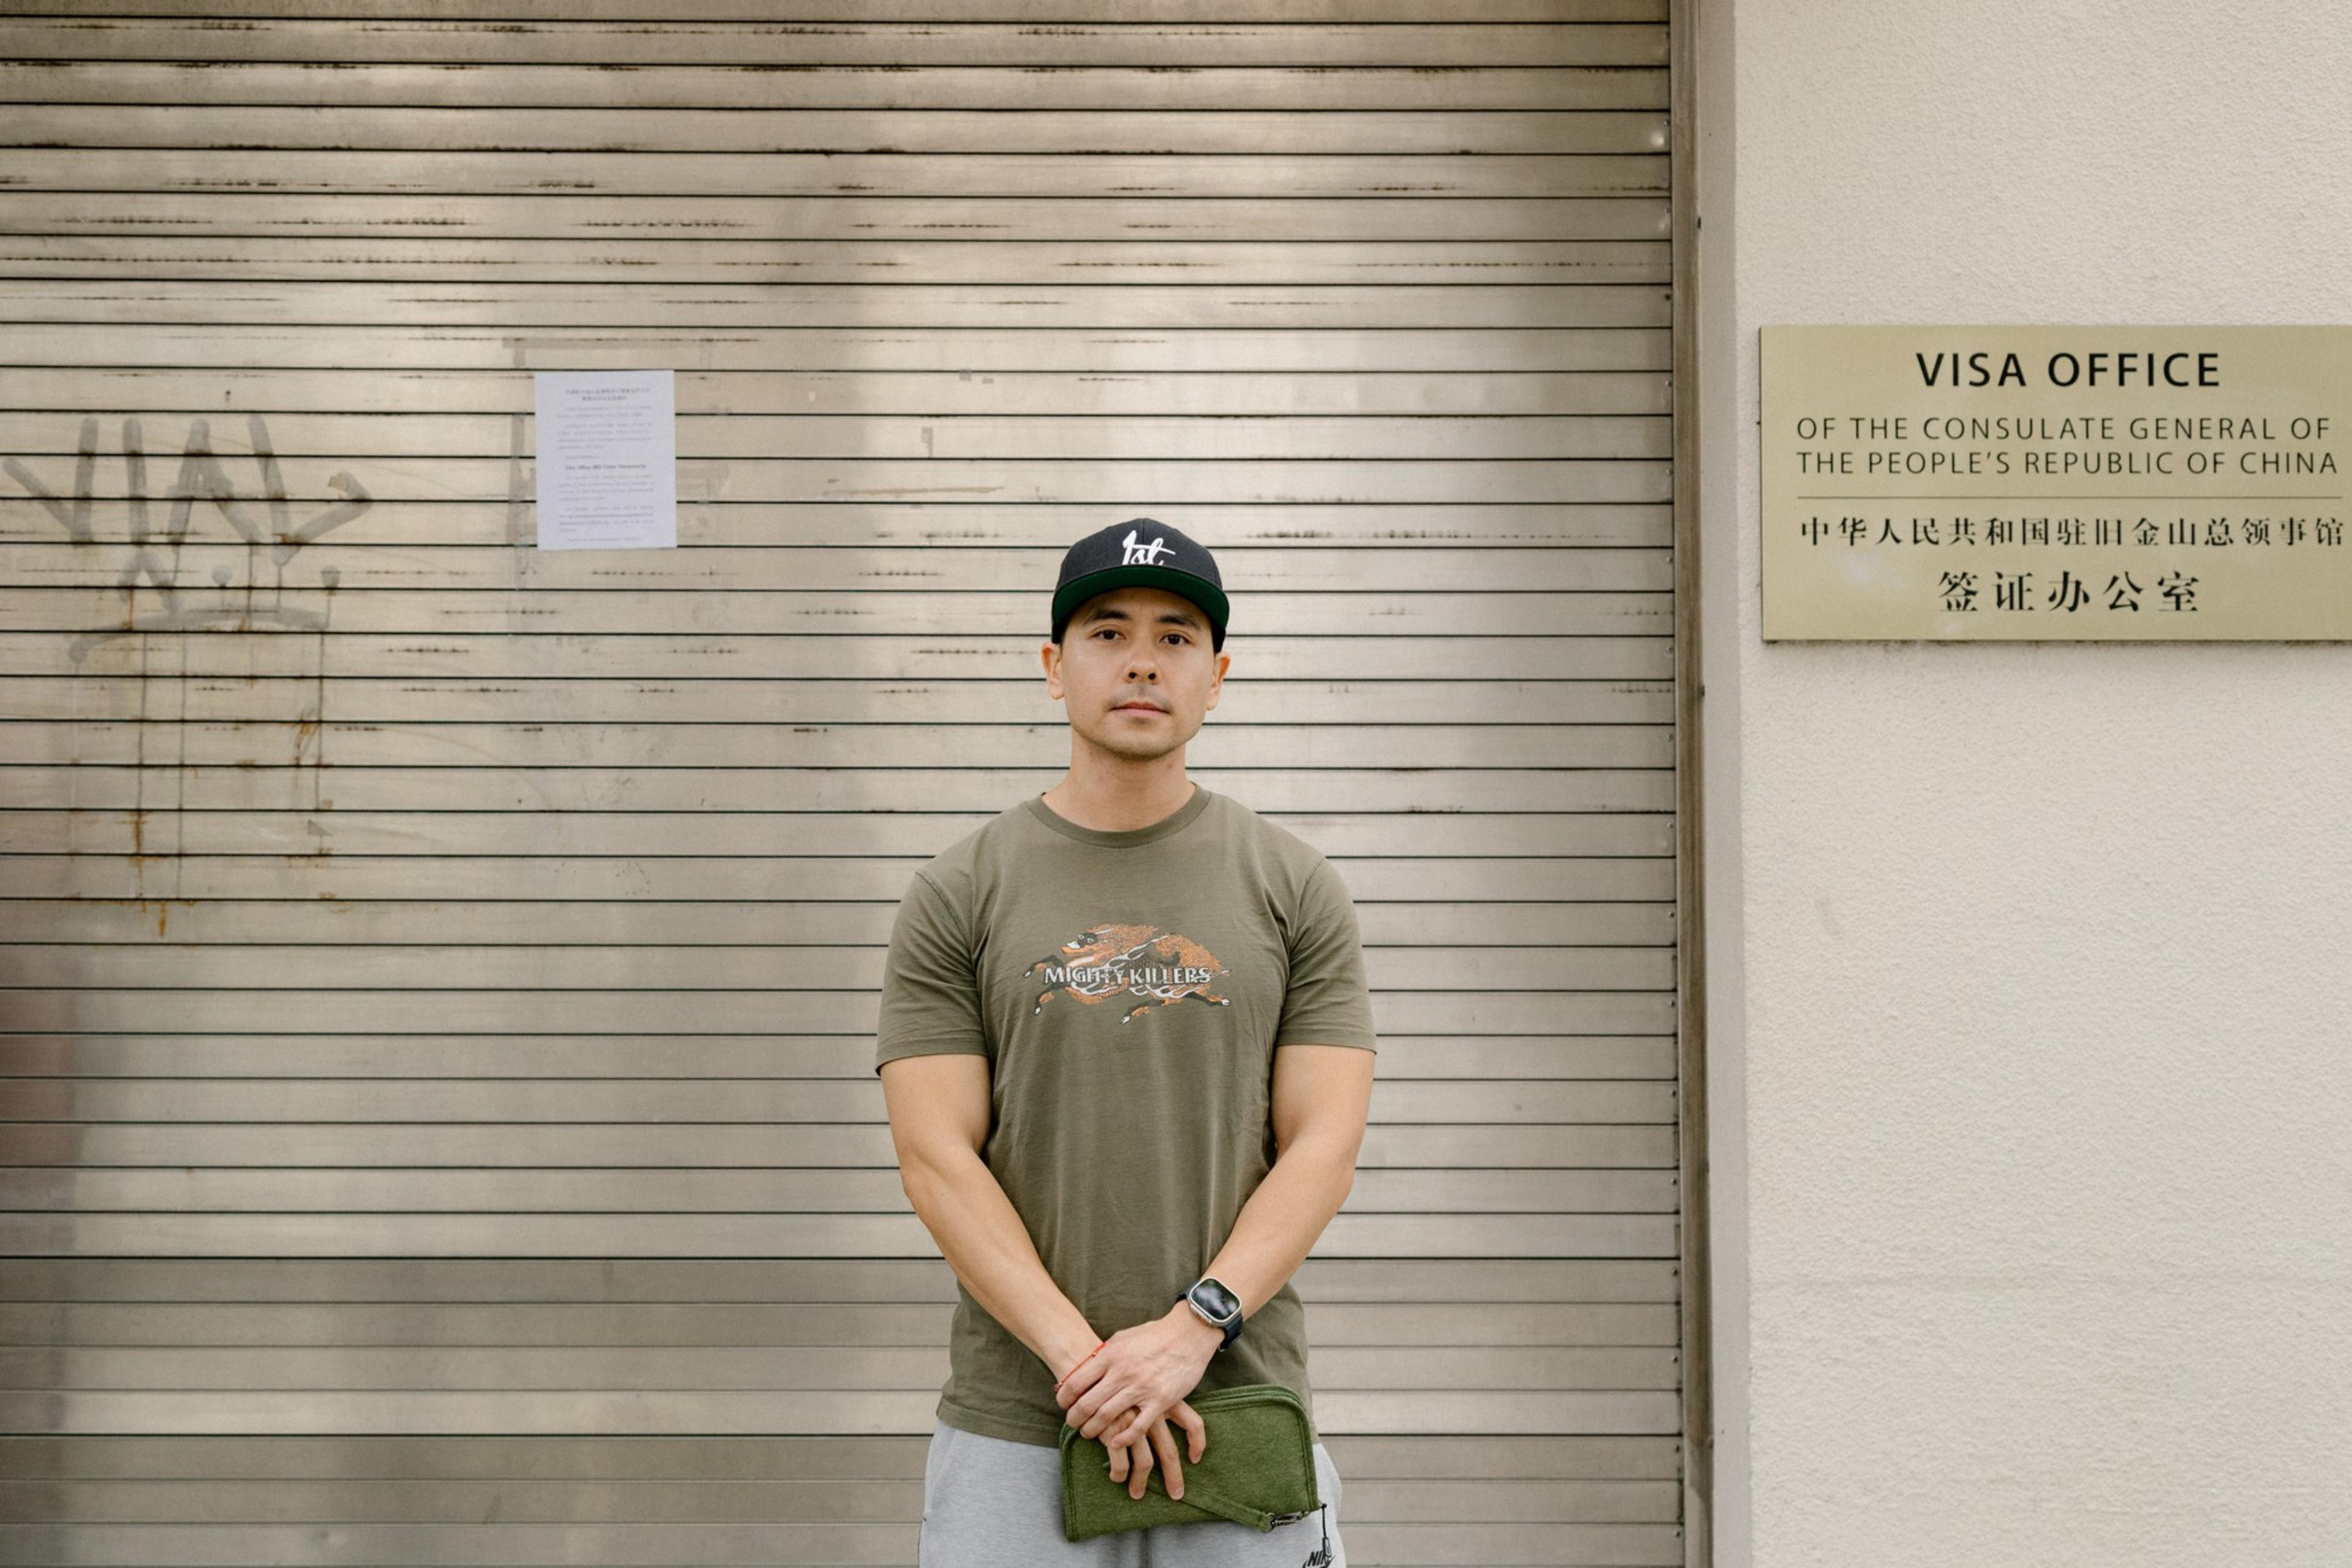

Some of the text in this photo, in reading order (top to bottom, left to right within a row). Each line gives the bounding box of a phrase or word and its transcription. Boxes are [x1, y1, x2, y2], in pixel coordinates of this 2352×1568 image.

[1915, 352, 2220, 387] VISA OFFICE
[1797, 417, 2330, 440] OF THE CONSULATE GENERAL OF
[1796, 451, 2338, 475] THE PEOPLE'S REPUBLIC OF CHINA
[1800, 516, 2345, 546] 中华人民共和国驻旧金山总领事馆
[1938, 570, 2200, 612] 签证办公室
[1044, 967, 1212, 984] MIGHTY KILLERS
